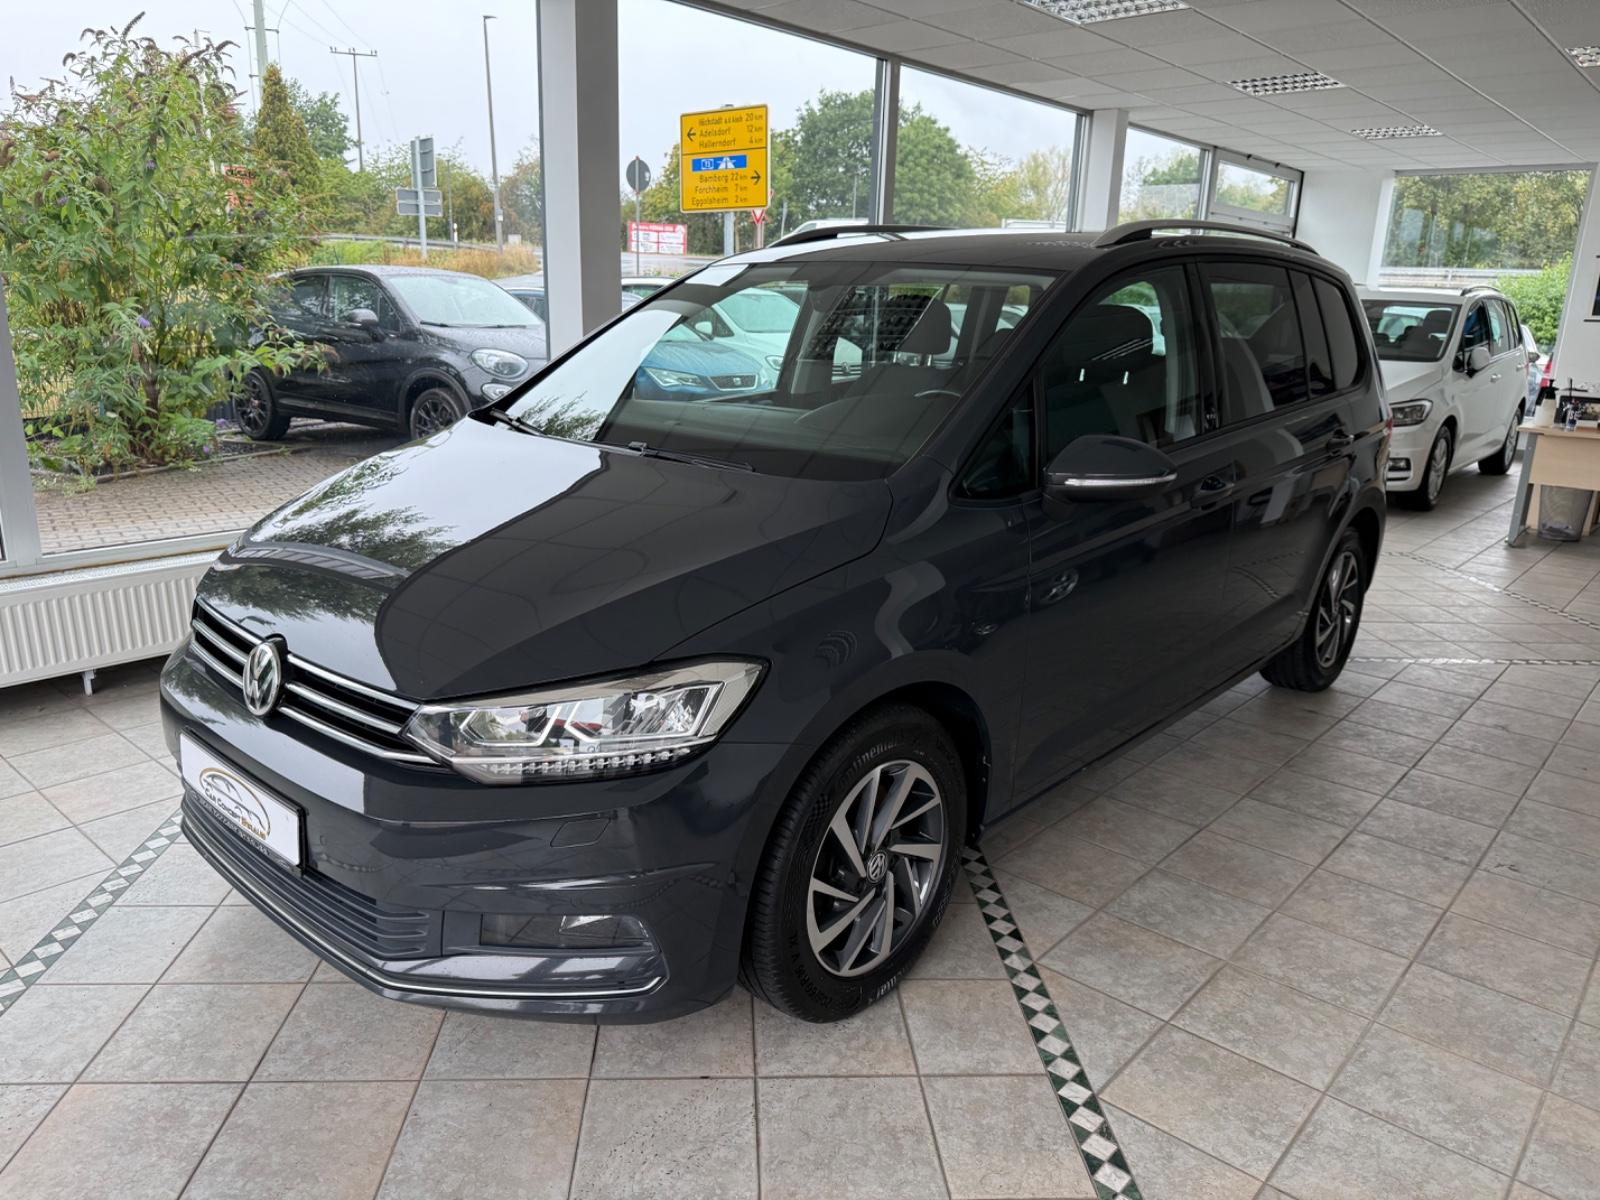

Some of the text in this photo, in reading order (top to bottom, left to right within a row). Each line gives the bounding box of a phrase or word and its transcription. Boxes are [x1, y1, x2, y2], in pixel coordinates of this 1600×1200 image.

[745, 113, 753, 122] 20
[699, 127, 731, 137] Adelsdorf
[747, 125, 753, 133] 12
[699, 138, 736, 149] Hallerndorf
[699, 174, 728, 183] Bamberg
[731, 172, 739, 181] 22
[695, 186, 728, 194] Forchheim
[691, 197, 728, 207] Eggolsheim
